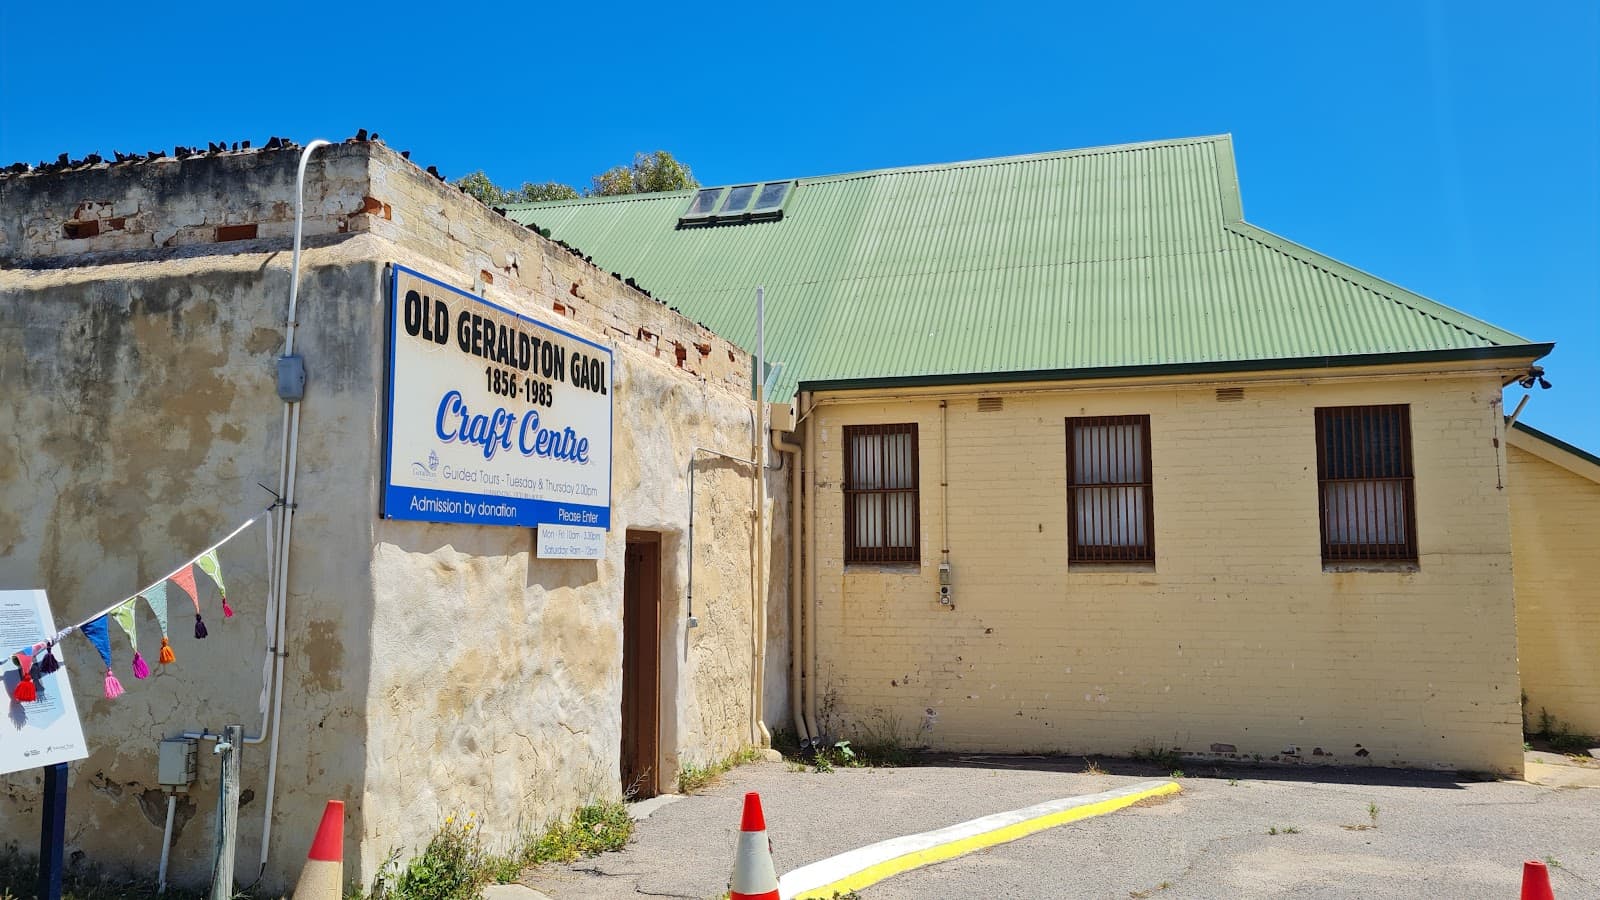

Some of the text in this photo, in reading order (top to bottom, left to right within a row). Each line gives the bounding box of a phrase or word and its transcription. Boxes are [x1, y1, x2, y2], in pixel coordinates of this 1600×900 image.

[404, 289, 607, 395] OLD GERALDTON GAOL
[436, 390, 590, 464] Craft Centre
[443, 465, 477, 482] Guided
[480, 470, 500, 485] Tours
[506, 473, 536, 490] Tuesday
[538, 478, 544, 490] &
[546, 479, 574, 496] Thursday
[410, 495, 517, 518] Admission by donation
[558, 508, 599, 523] Please Enter
